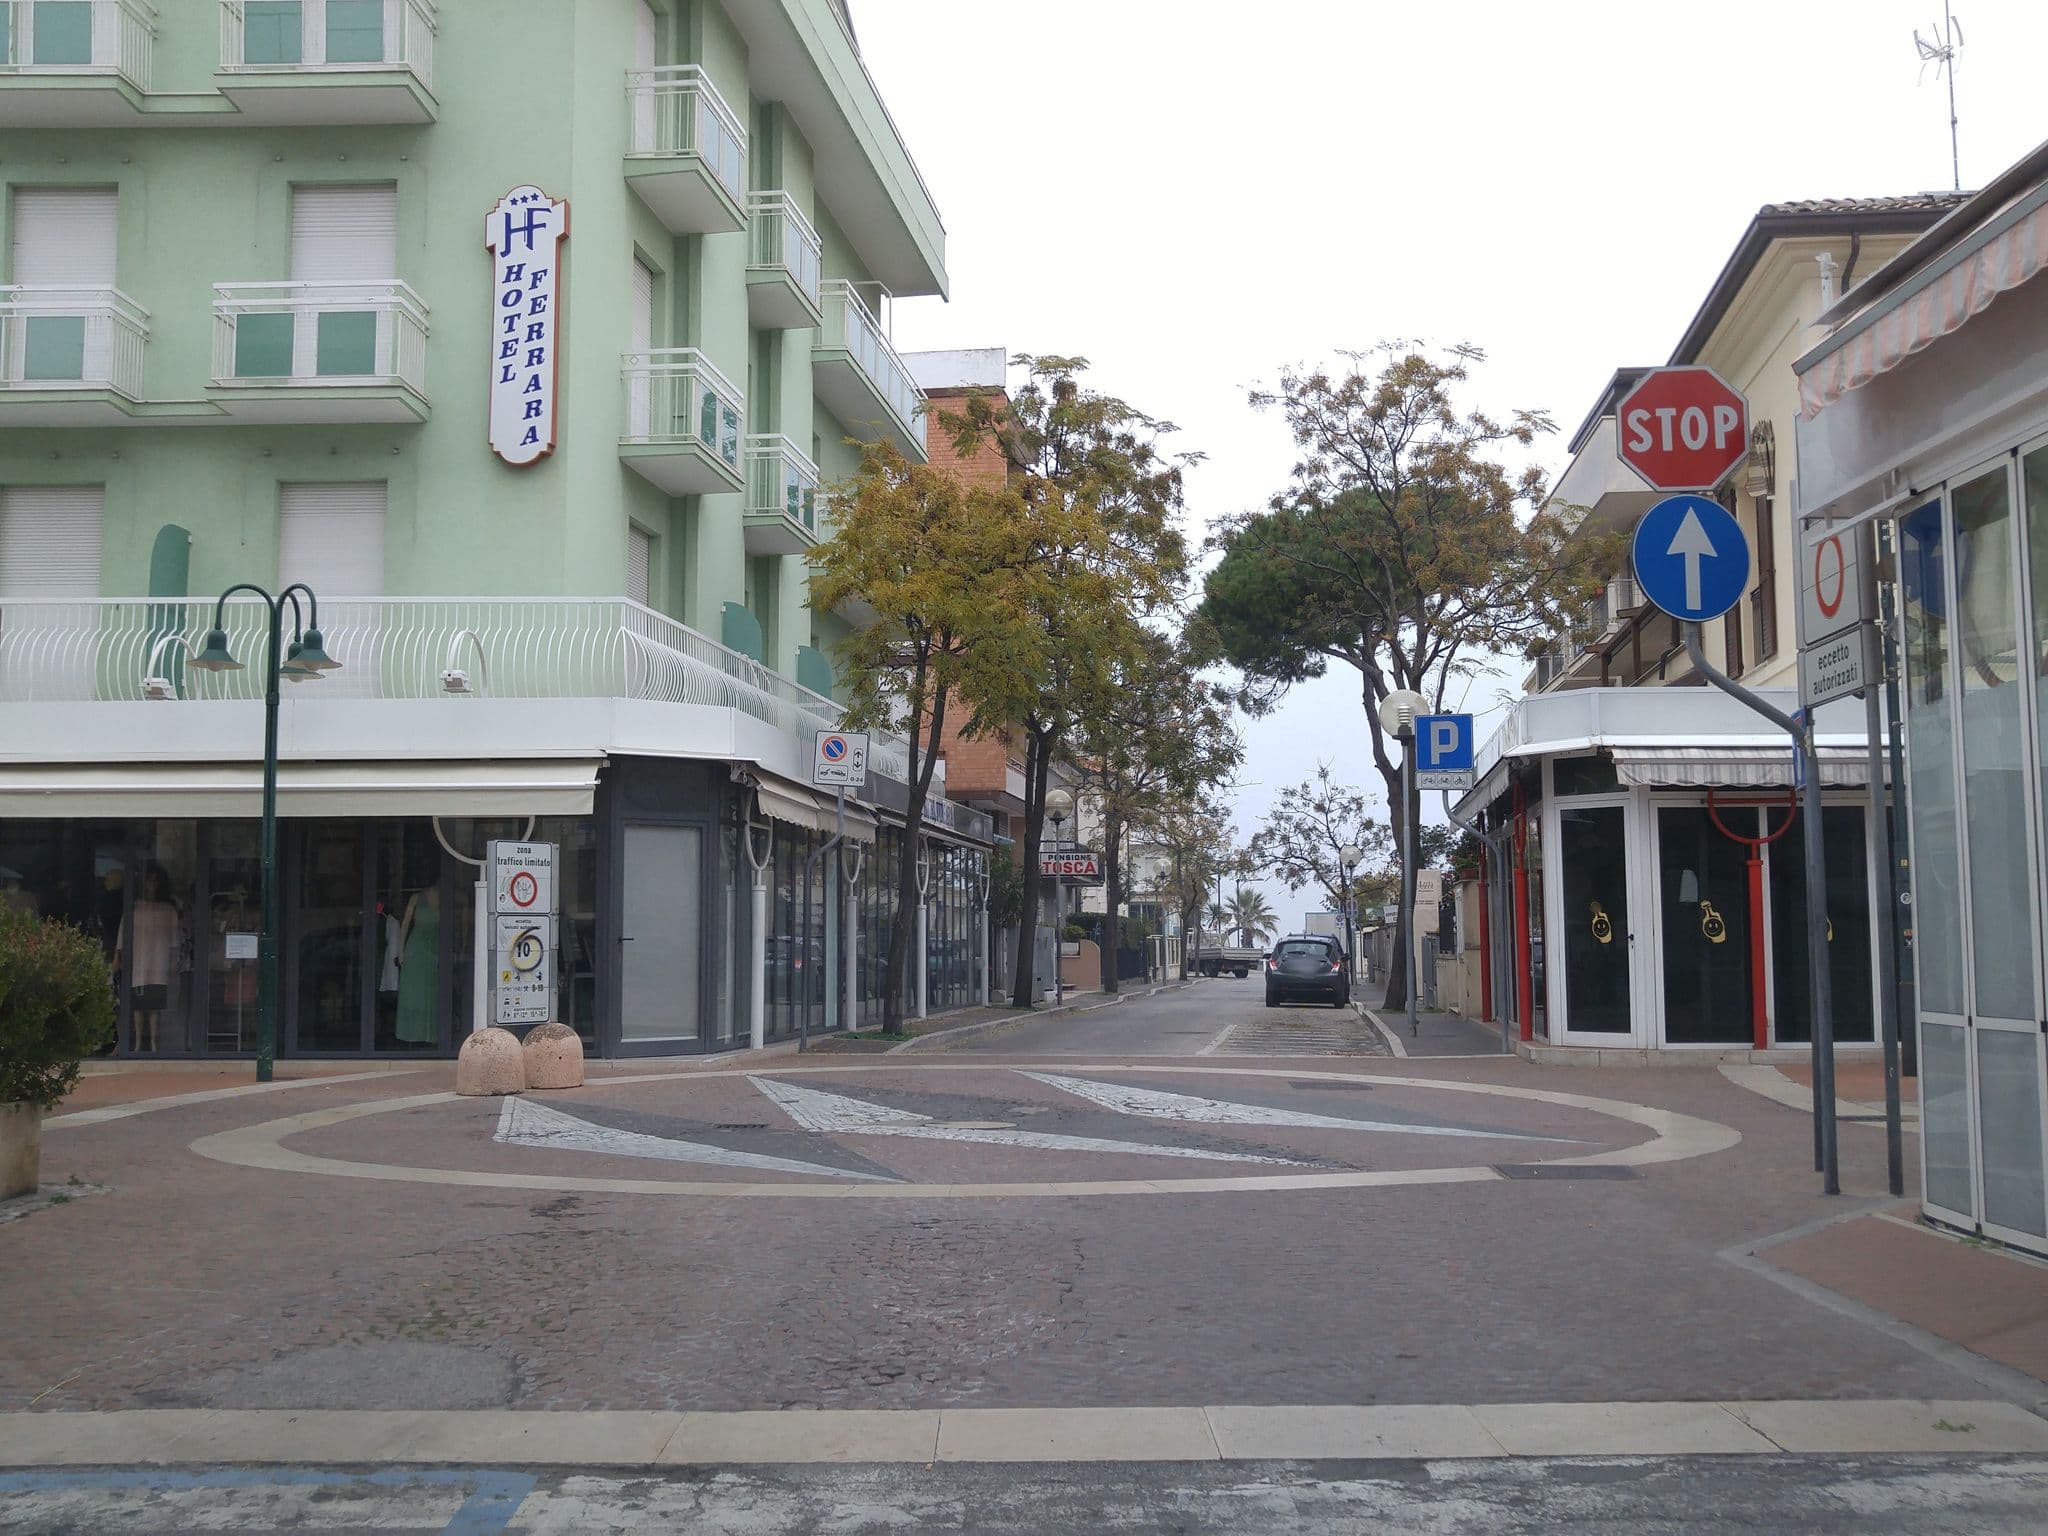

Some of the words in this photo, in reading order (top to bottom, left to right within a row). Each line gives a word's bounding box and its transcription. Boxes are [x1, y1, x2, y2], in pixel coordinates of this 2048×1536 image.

[499, 262, 526, 384] HOTEL
[520, 268, 548, 446] FERRARA
[1627, 405, 1738, 453] STOP
[1818, 643, 1849, 670] eccetto
[1813, 661, 1858, 695] autorizzati
[1430, 720, 1459, 765] P
[498, 856, 523, 866] traffico
[1042, 861, 1097, 874] TOSCA
[517, 942, 530, 958] 10
